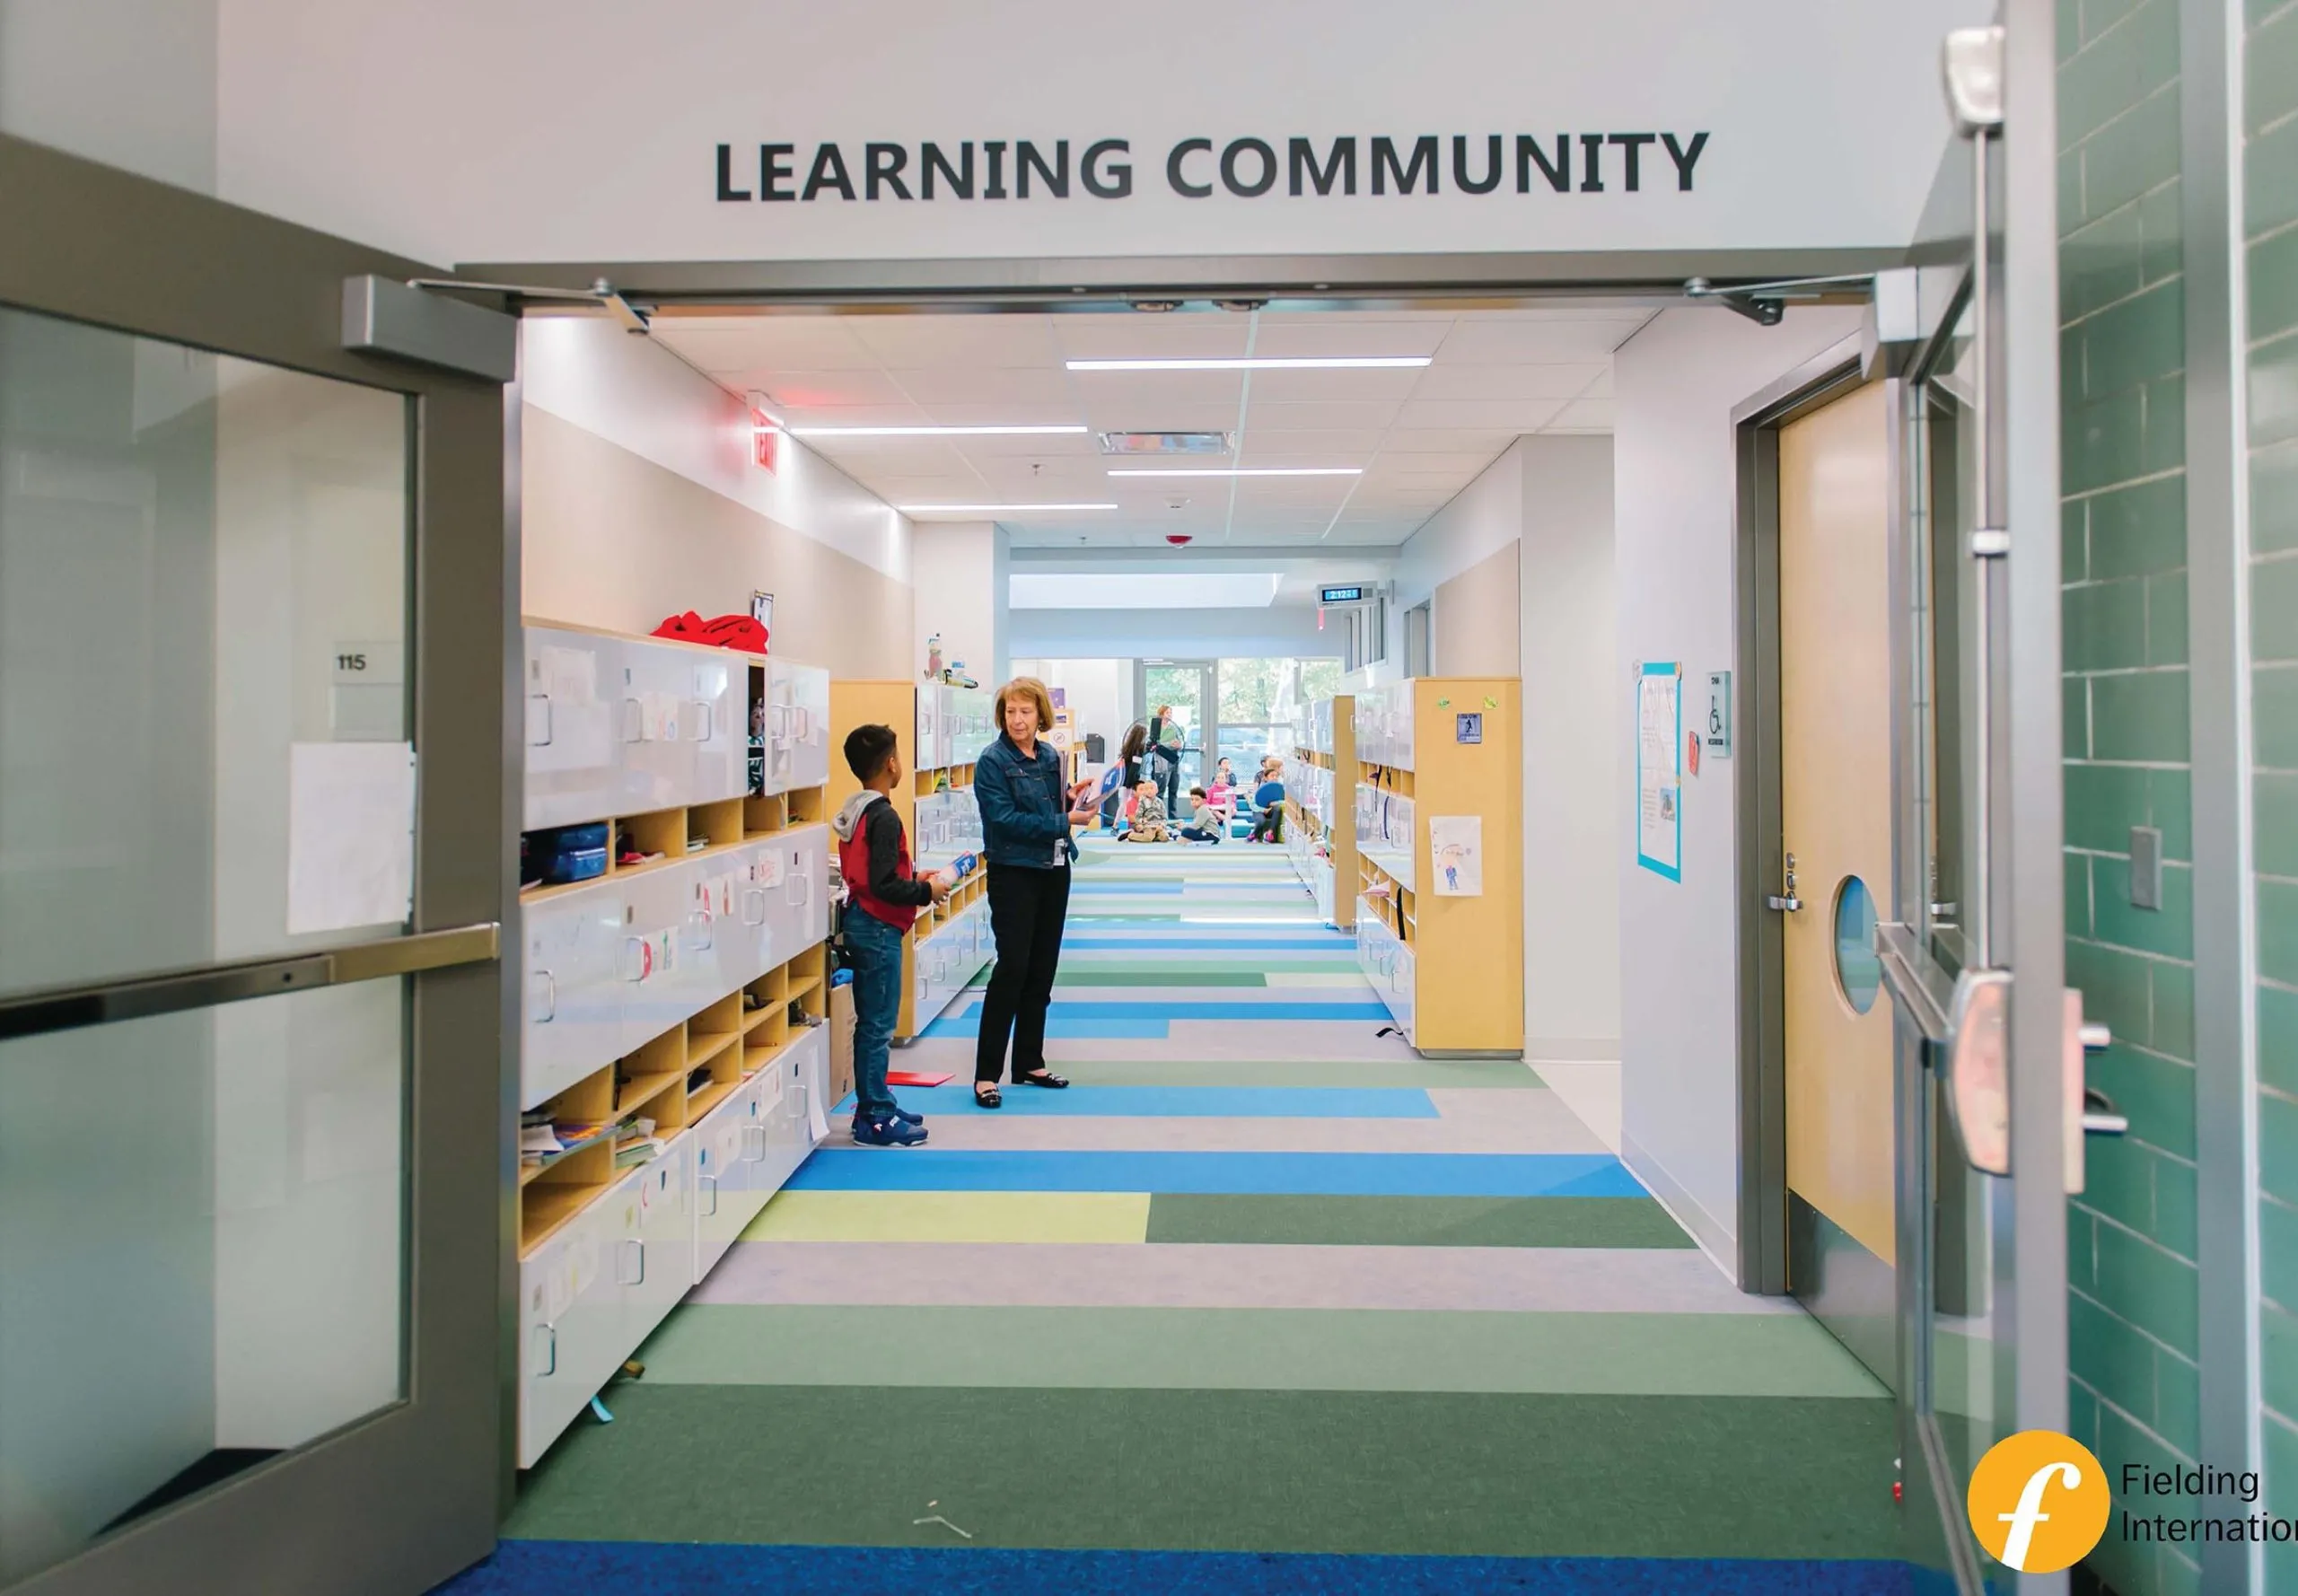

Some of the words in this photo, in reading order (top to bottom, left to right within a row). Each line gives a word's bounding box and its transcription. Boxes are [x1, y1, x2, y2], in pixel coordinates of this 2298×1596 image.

[716, 139, 1132, 202] LEARNING
[1166, 132, 1710, 198] COMMUNITY
[338, 653, 366, 671] 115
